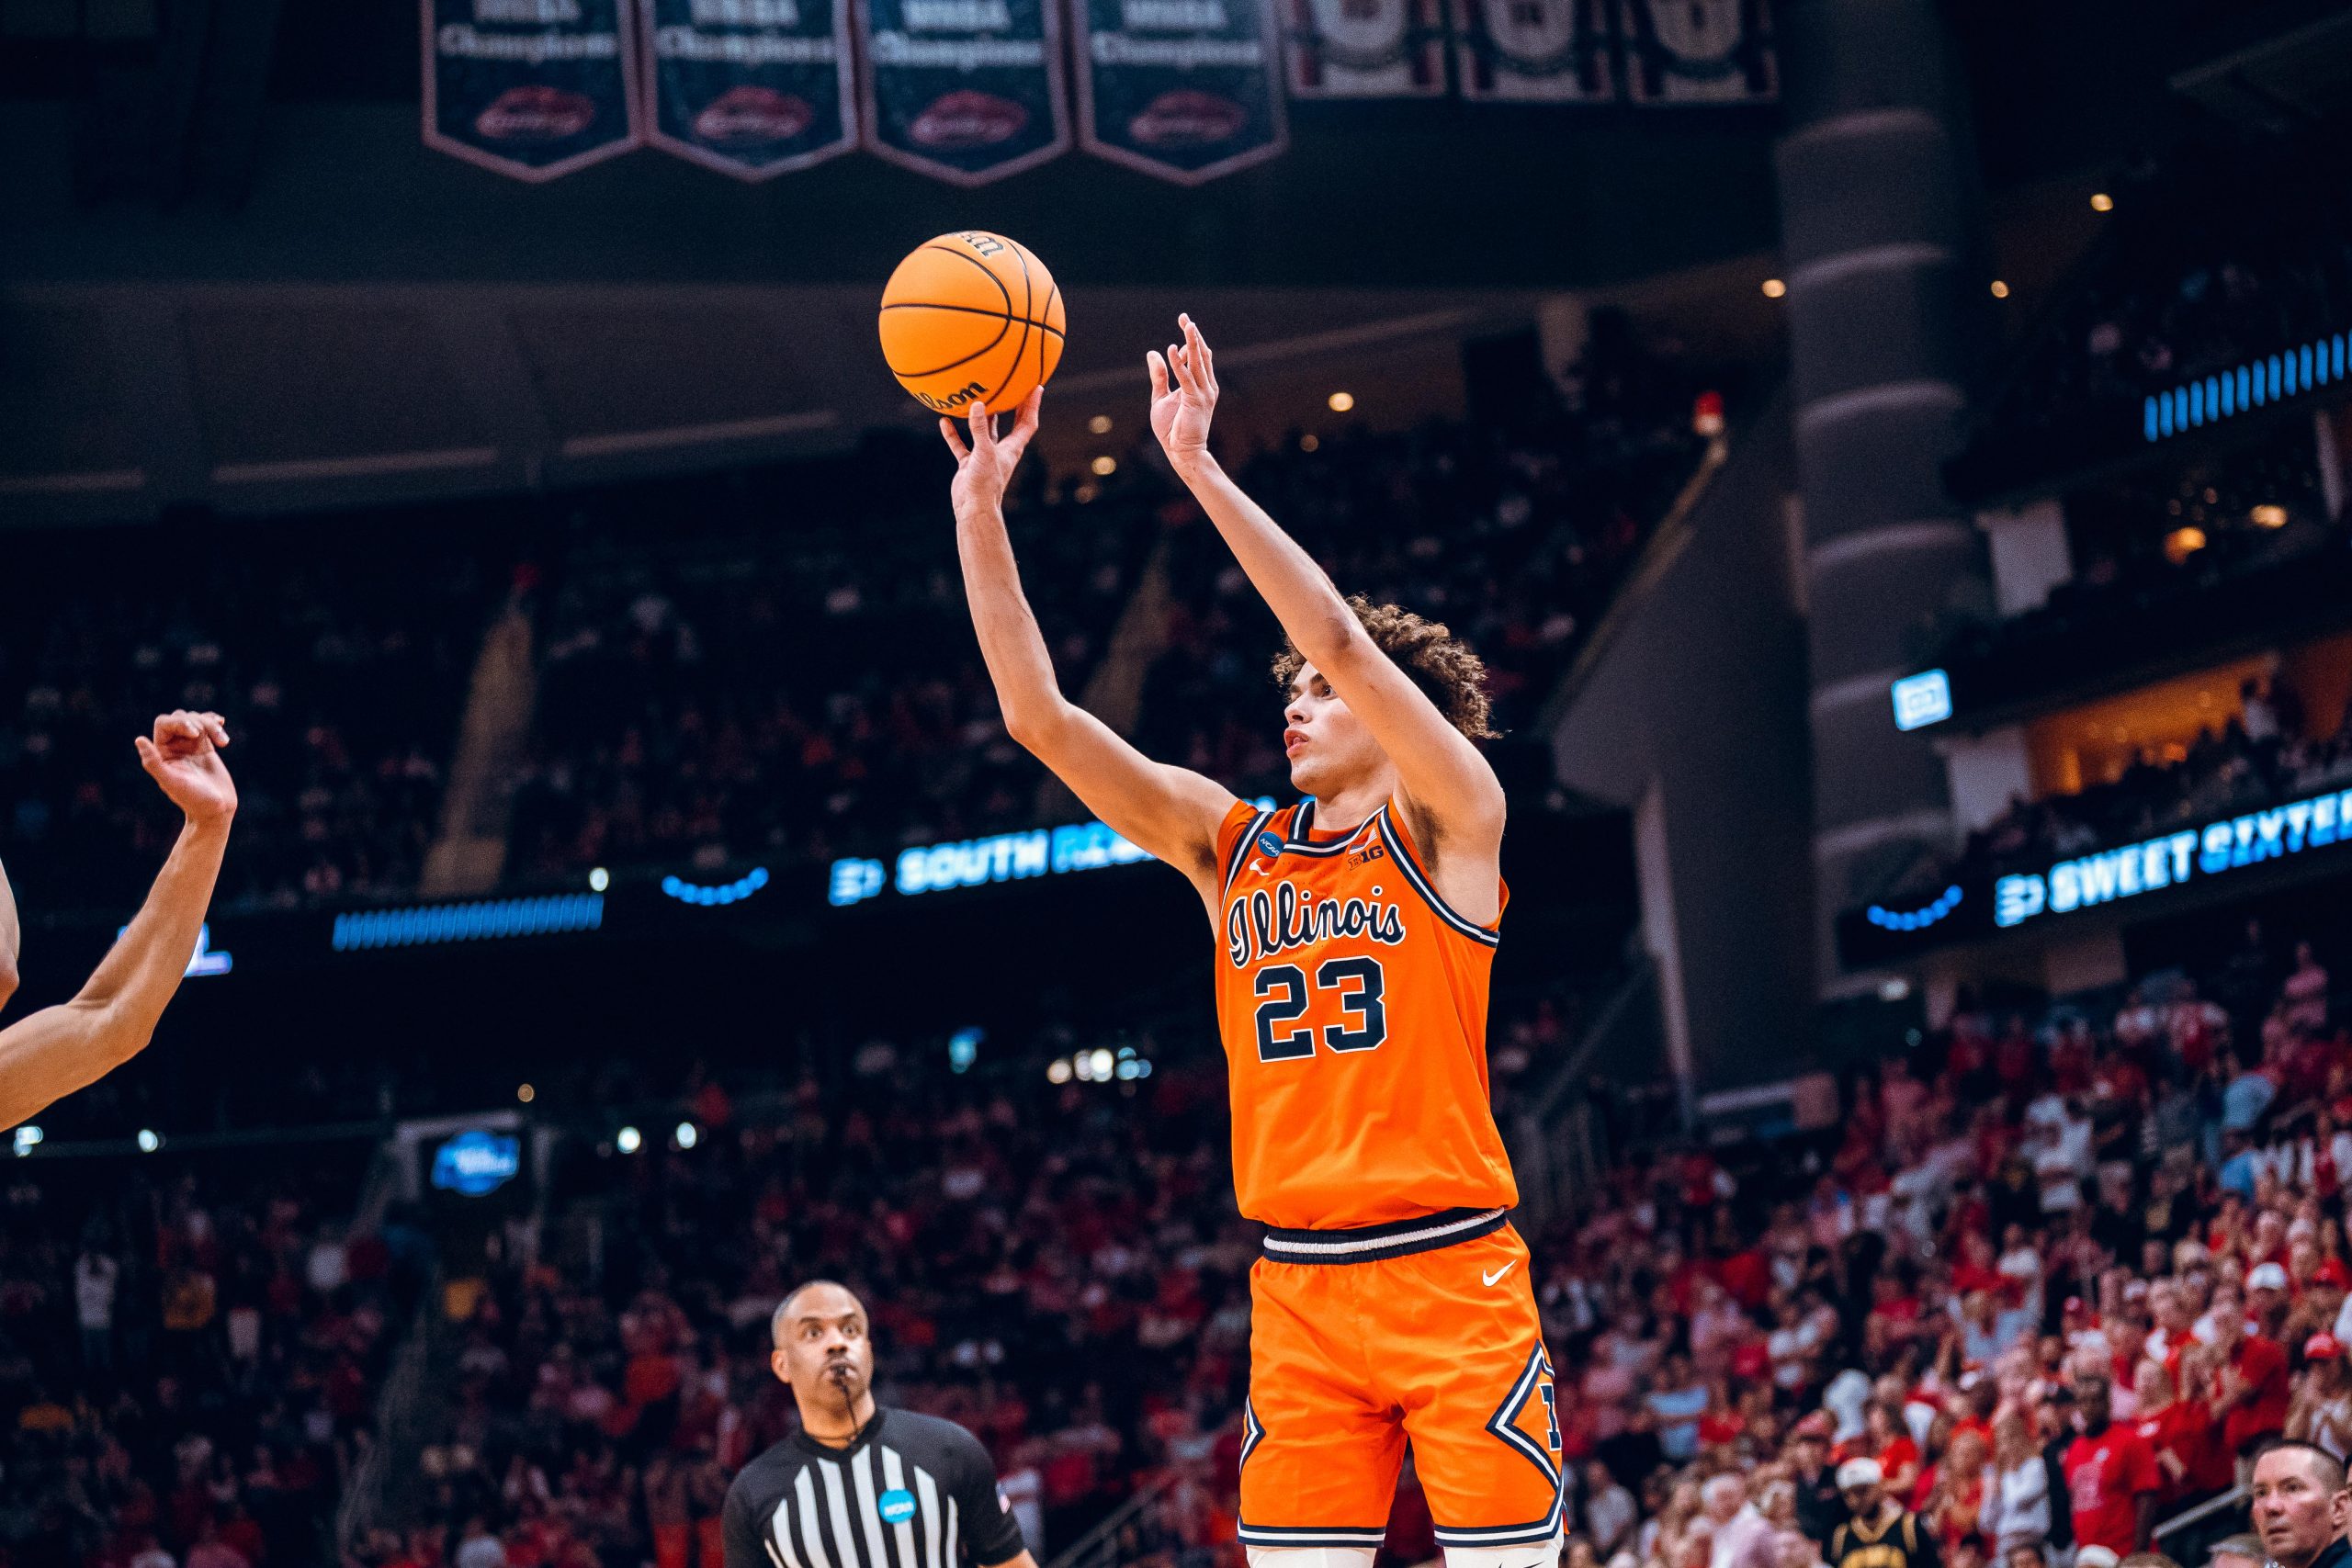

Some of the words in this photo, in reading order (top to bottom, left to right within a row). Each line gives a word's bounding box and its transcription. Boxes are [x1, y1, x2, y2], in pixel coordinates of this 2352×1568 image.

[895, 829, 1050, 896] SOUTH
[1260, 837, 1281, 857] NCAA
[2049, 829, 2198, 913] SWEET
[1228, 880, 1406, 969] Illinois
[1254, 955, 1387, 1063] 23
